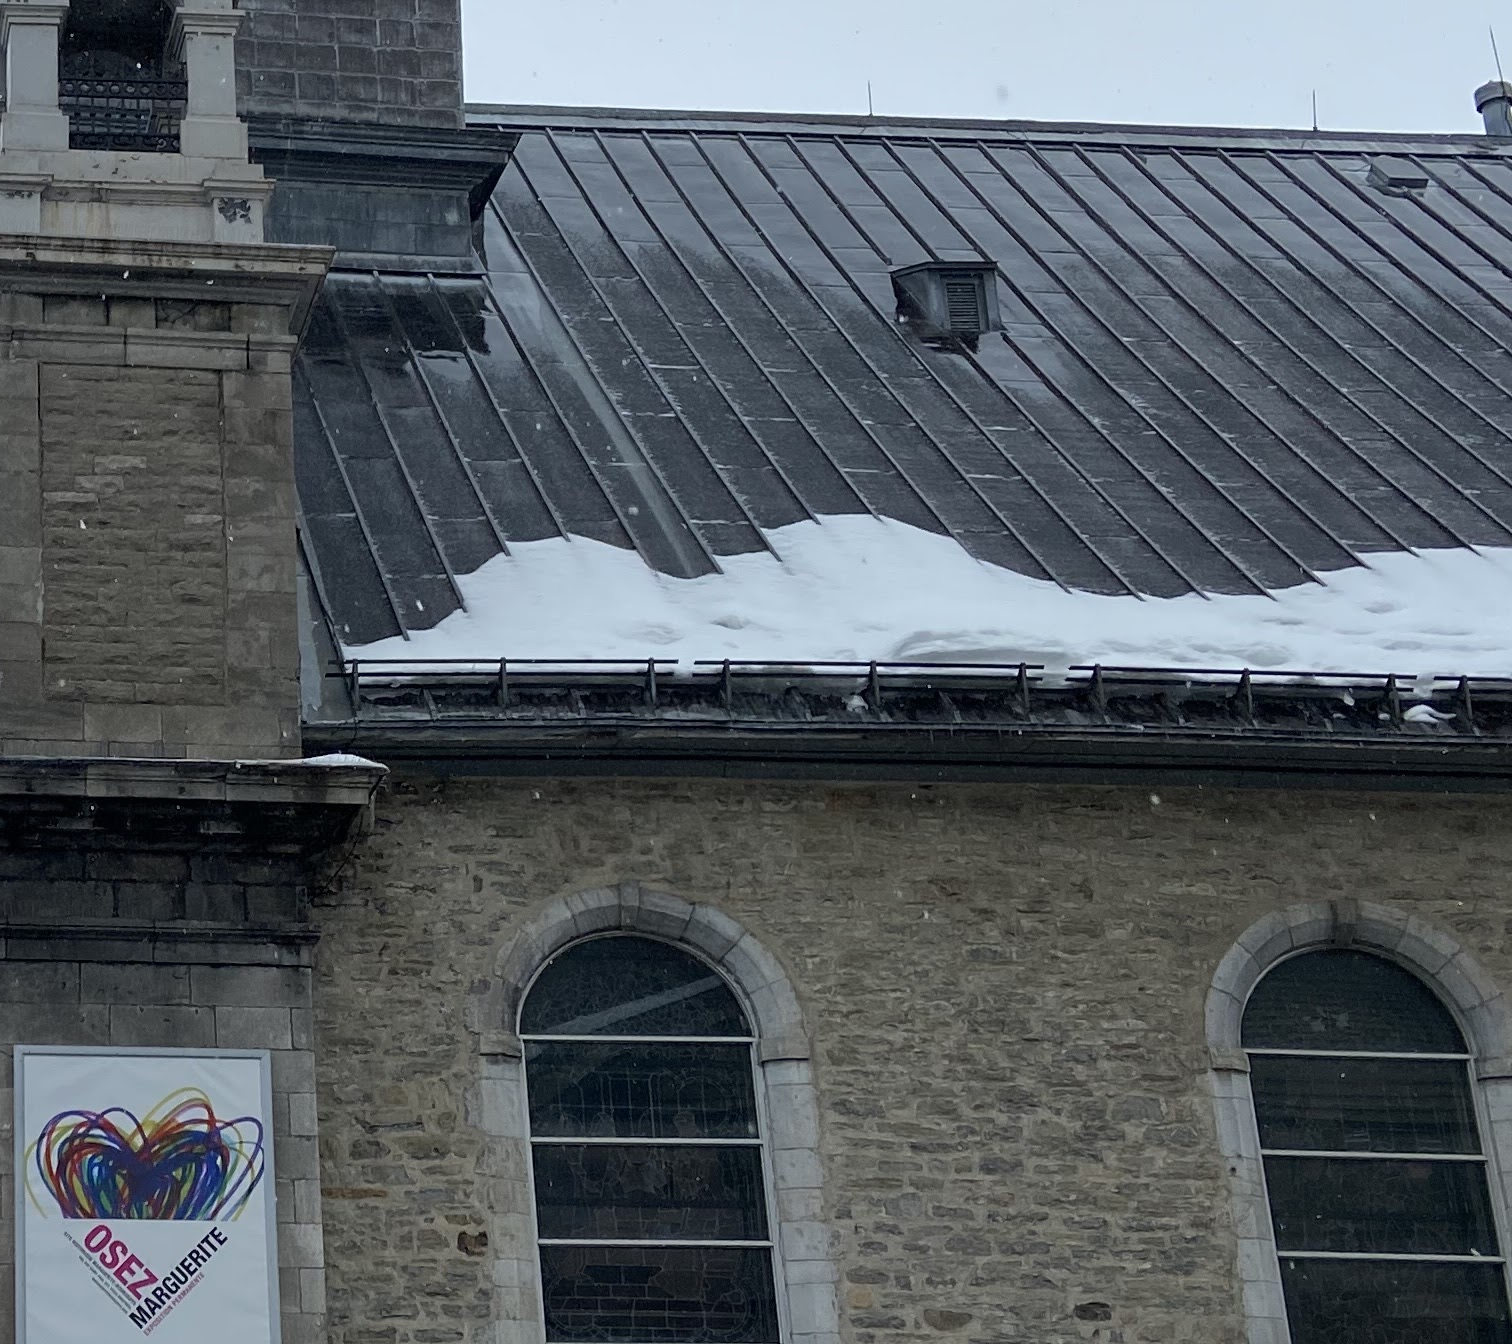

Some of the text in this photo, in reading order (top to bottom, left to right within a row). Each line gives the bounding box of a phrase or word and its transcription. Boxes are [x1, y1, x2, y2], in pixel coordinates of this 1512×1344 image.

[84, 1224, 159, 1301] OSEZ
[129, 1226, 228, 1329] MARGUERITE
[143, 1271, 205, 1337] EXPOSITION PERMANENTE
